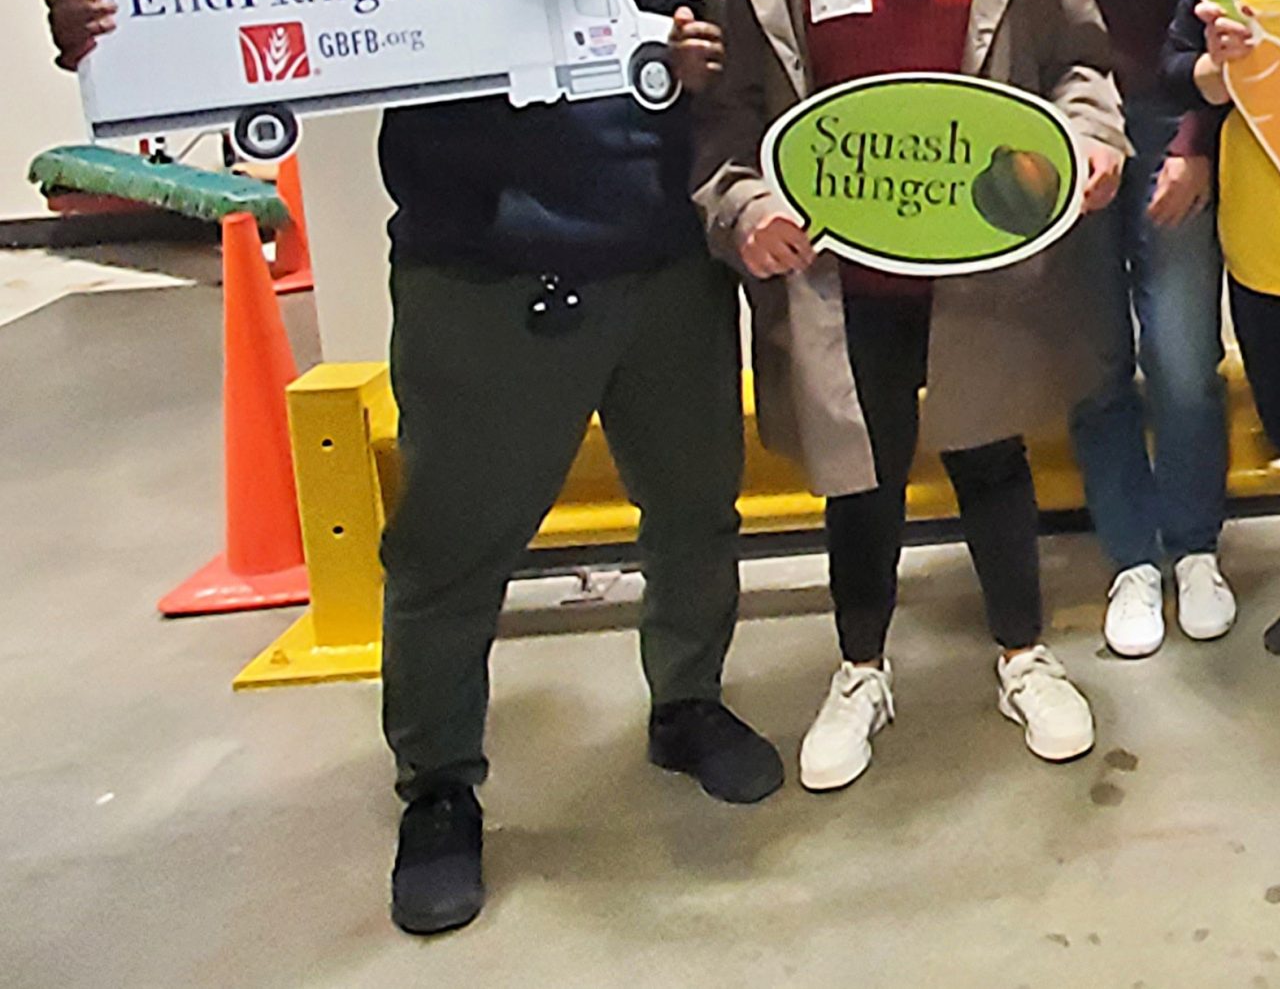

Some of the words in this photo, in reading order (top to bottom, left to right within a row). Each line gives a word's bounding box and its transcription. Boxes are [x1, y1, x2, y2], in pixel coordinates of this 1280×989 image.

[318, 27, 425, 59] GBFB.org
[810, 115, 972, 173] Squash
[813, 157, 967, 218] hunger
